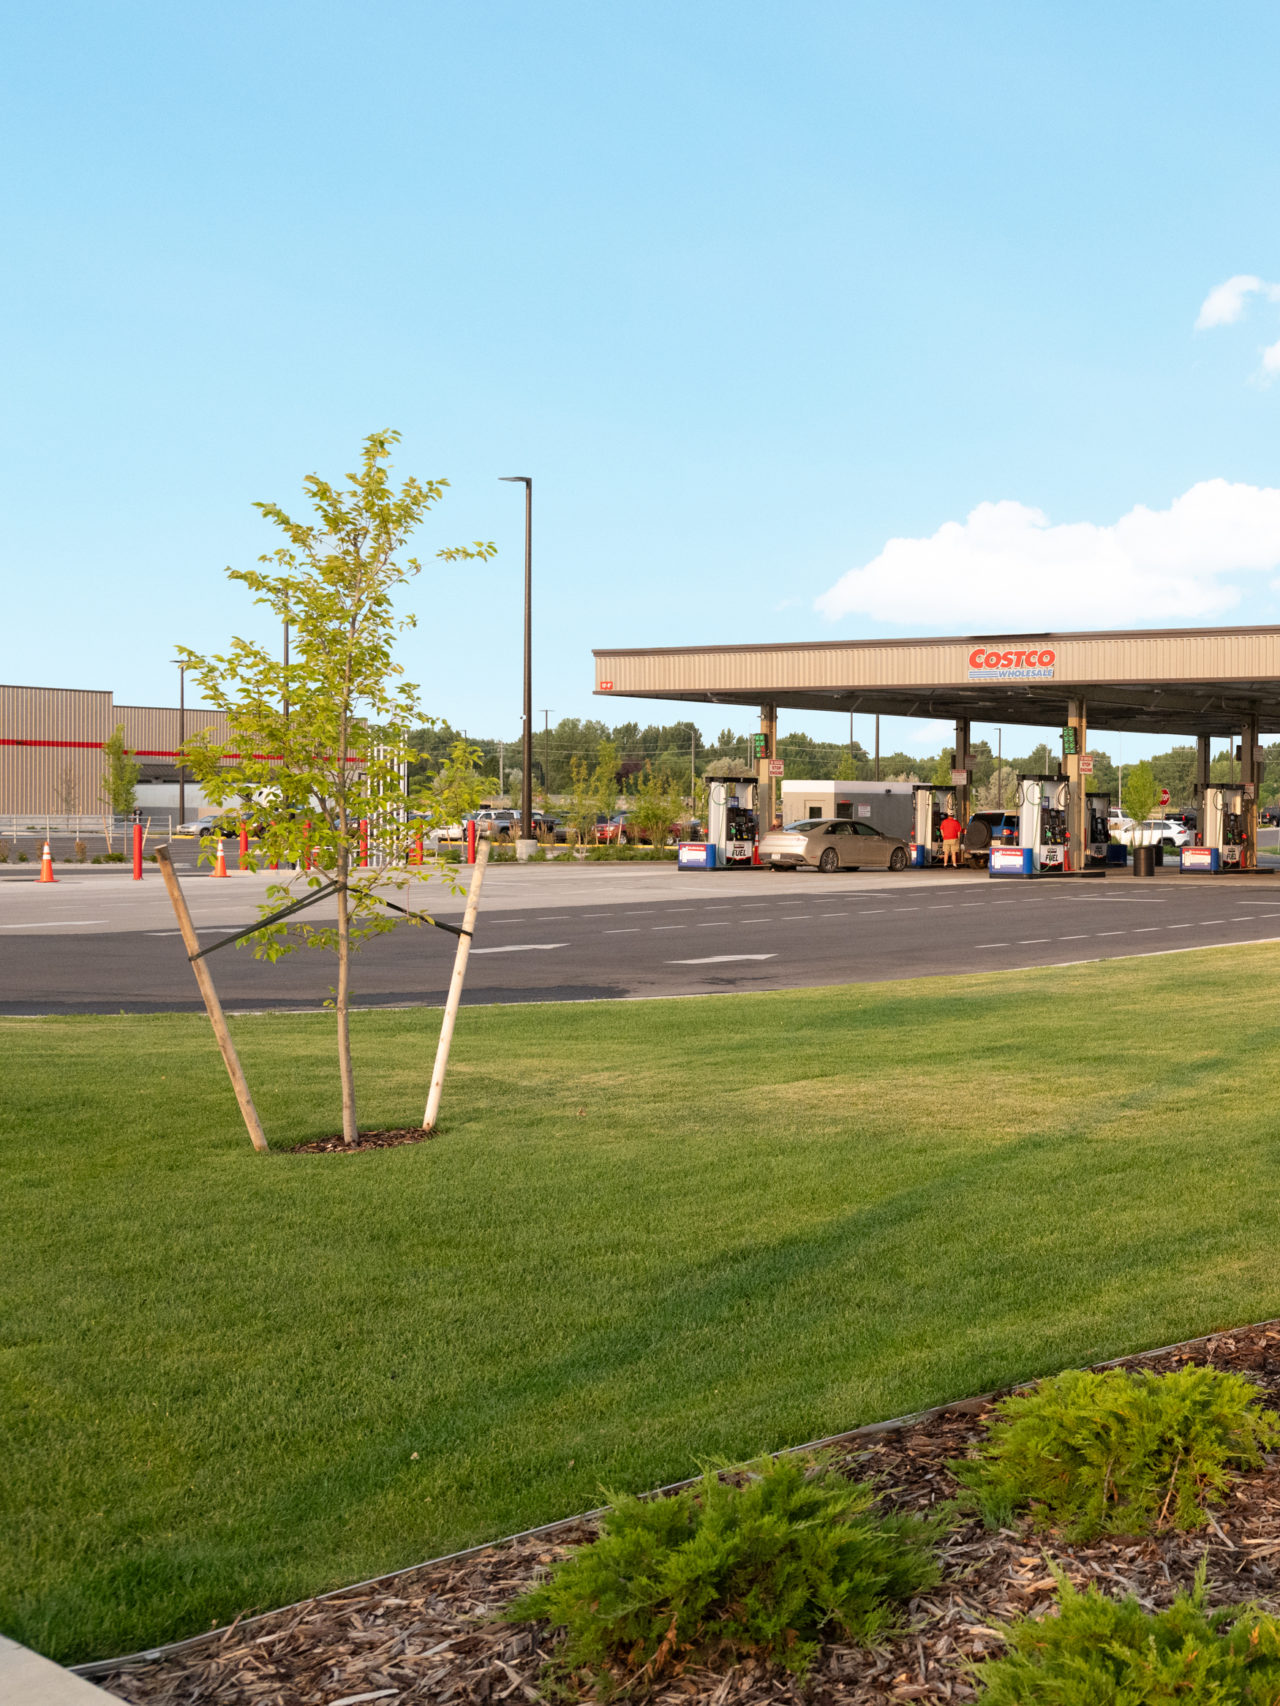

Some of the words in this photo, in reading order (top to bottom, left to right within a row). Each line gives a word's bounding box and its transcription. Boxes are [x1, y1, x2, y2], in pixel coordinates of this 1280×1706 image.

[969, 648, 1056, 668] COSTCO
[998, 669, 1053, 677] WHOLESALE
[1045, 854, 1059, 862] FUEL
